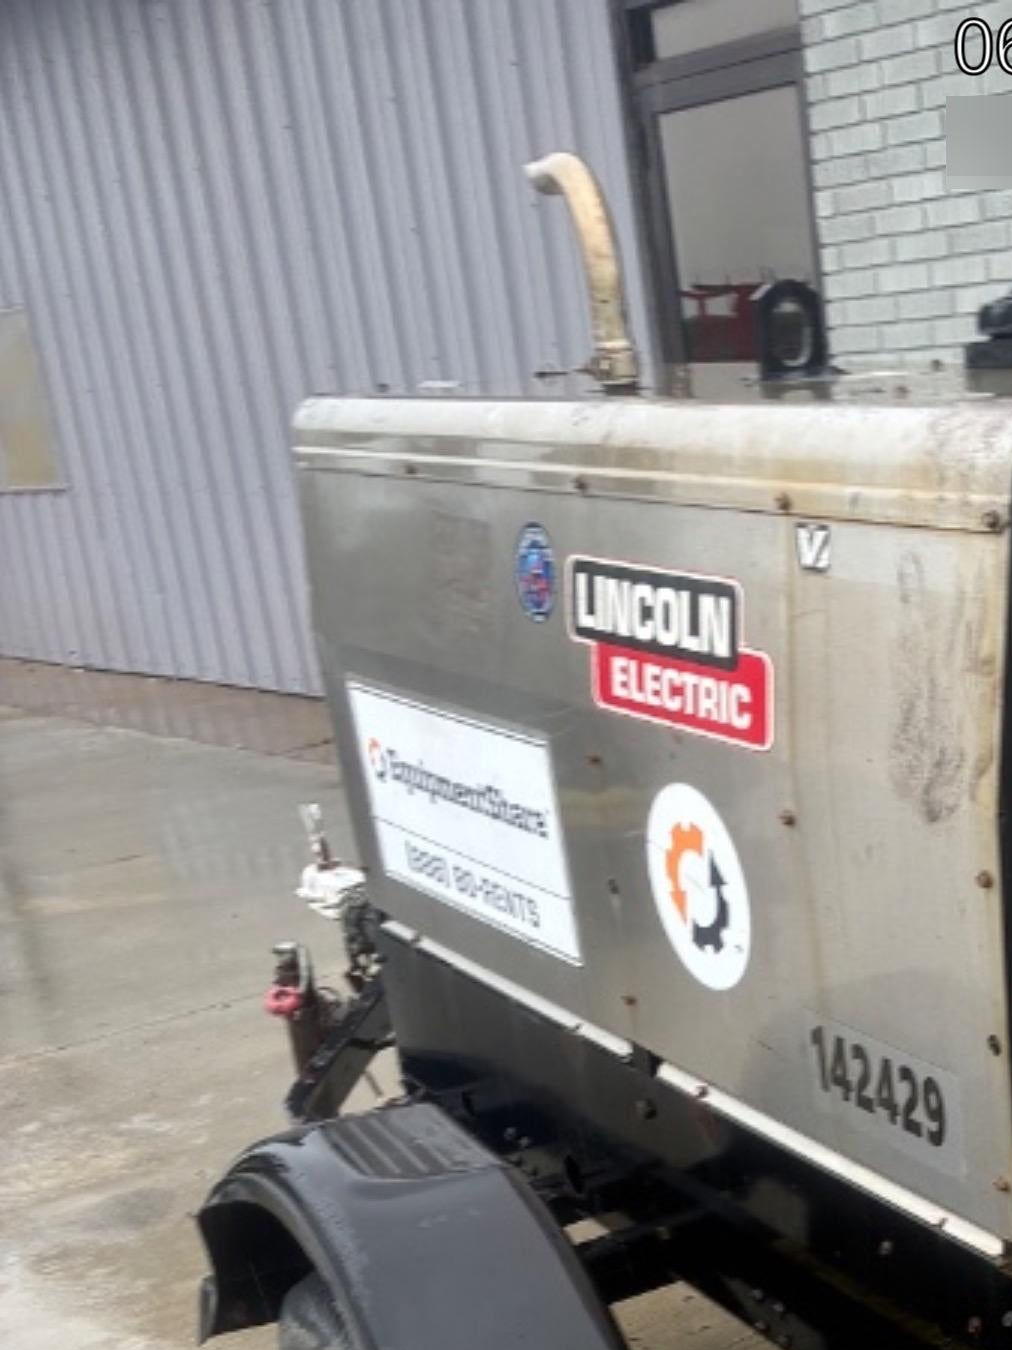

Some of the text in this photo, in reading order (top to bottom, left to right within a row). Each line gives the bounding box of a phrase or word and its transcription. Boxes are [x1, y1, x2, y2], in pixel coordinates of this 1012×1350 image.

[574, 571, 733, 659] LINCOLN
[609, 655, 753, 730] ELECTRIC
[810, 1024, 947, 1147] 142429
